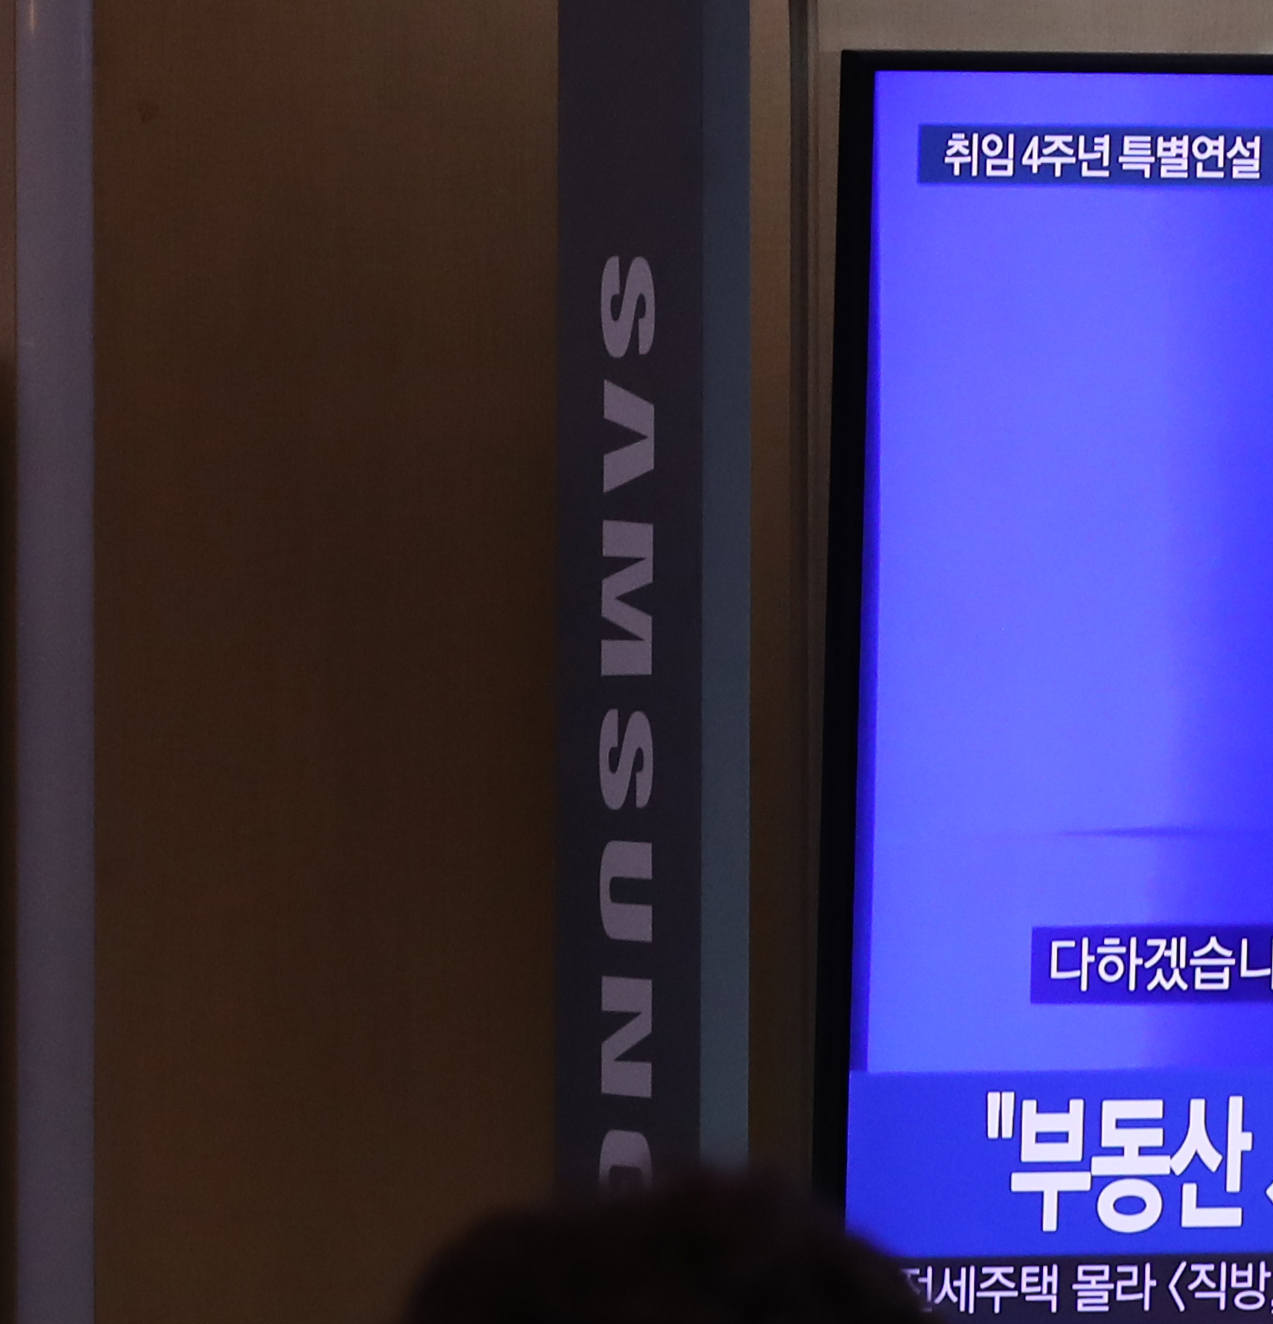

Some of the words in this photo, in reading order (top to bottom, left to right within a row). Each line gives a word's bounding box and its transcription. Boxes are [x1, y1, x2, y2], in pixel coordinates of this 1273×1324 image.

[944, 132, 1015, 177] 취임
[1021, 134, 1110, 178] 4주년
[1118, 134, 1261, 179] 특별연설
[986, 1090, 1253, 1234] "부동산
[1072, 1261, 1157, 1313] 몰라
